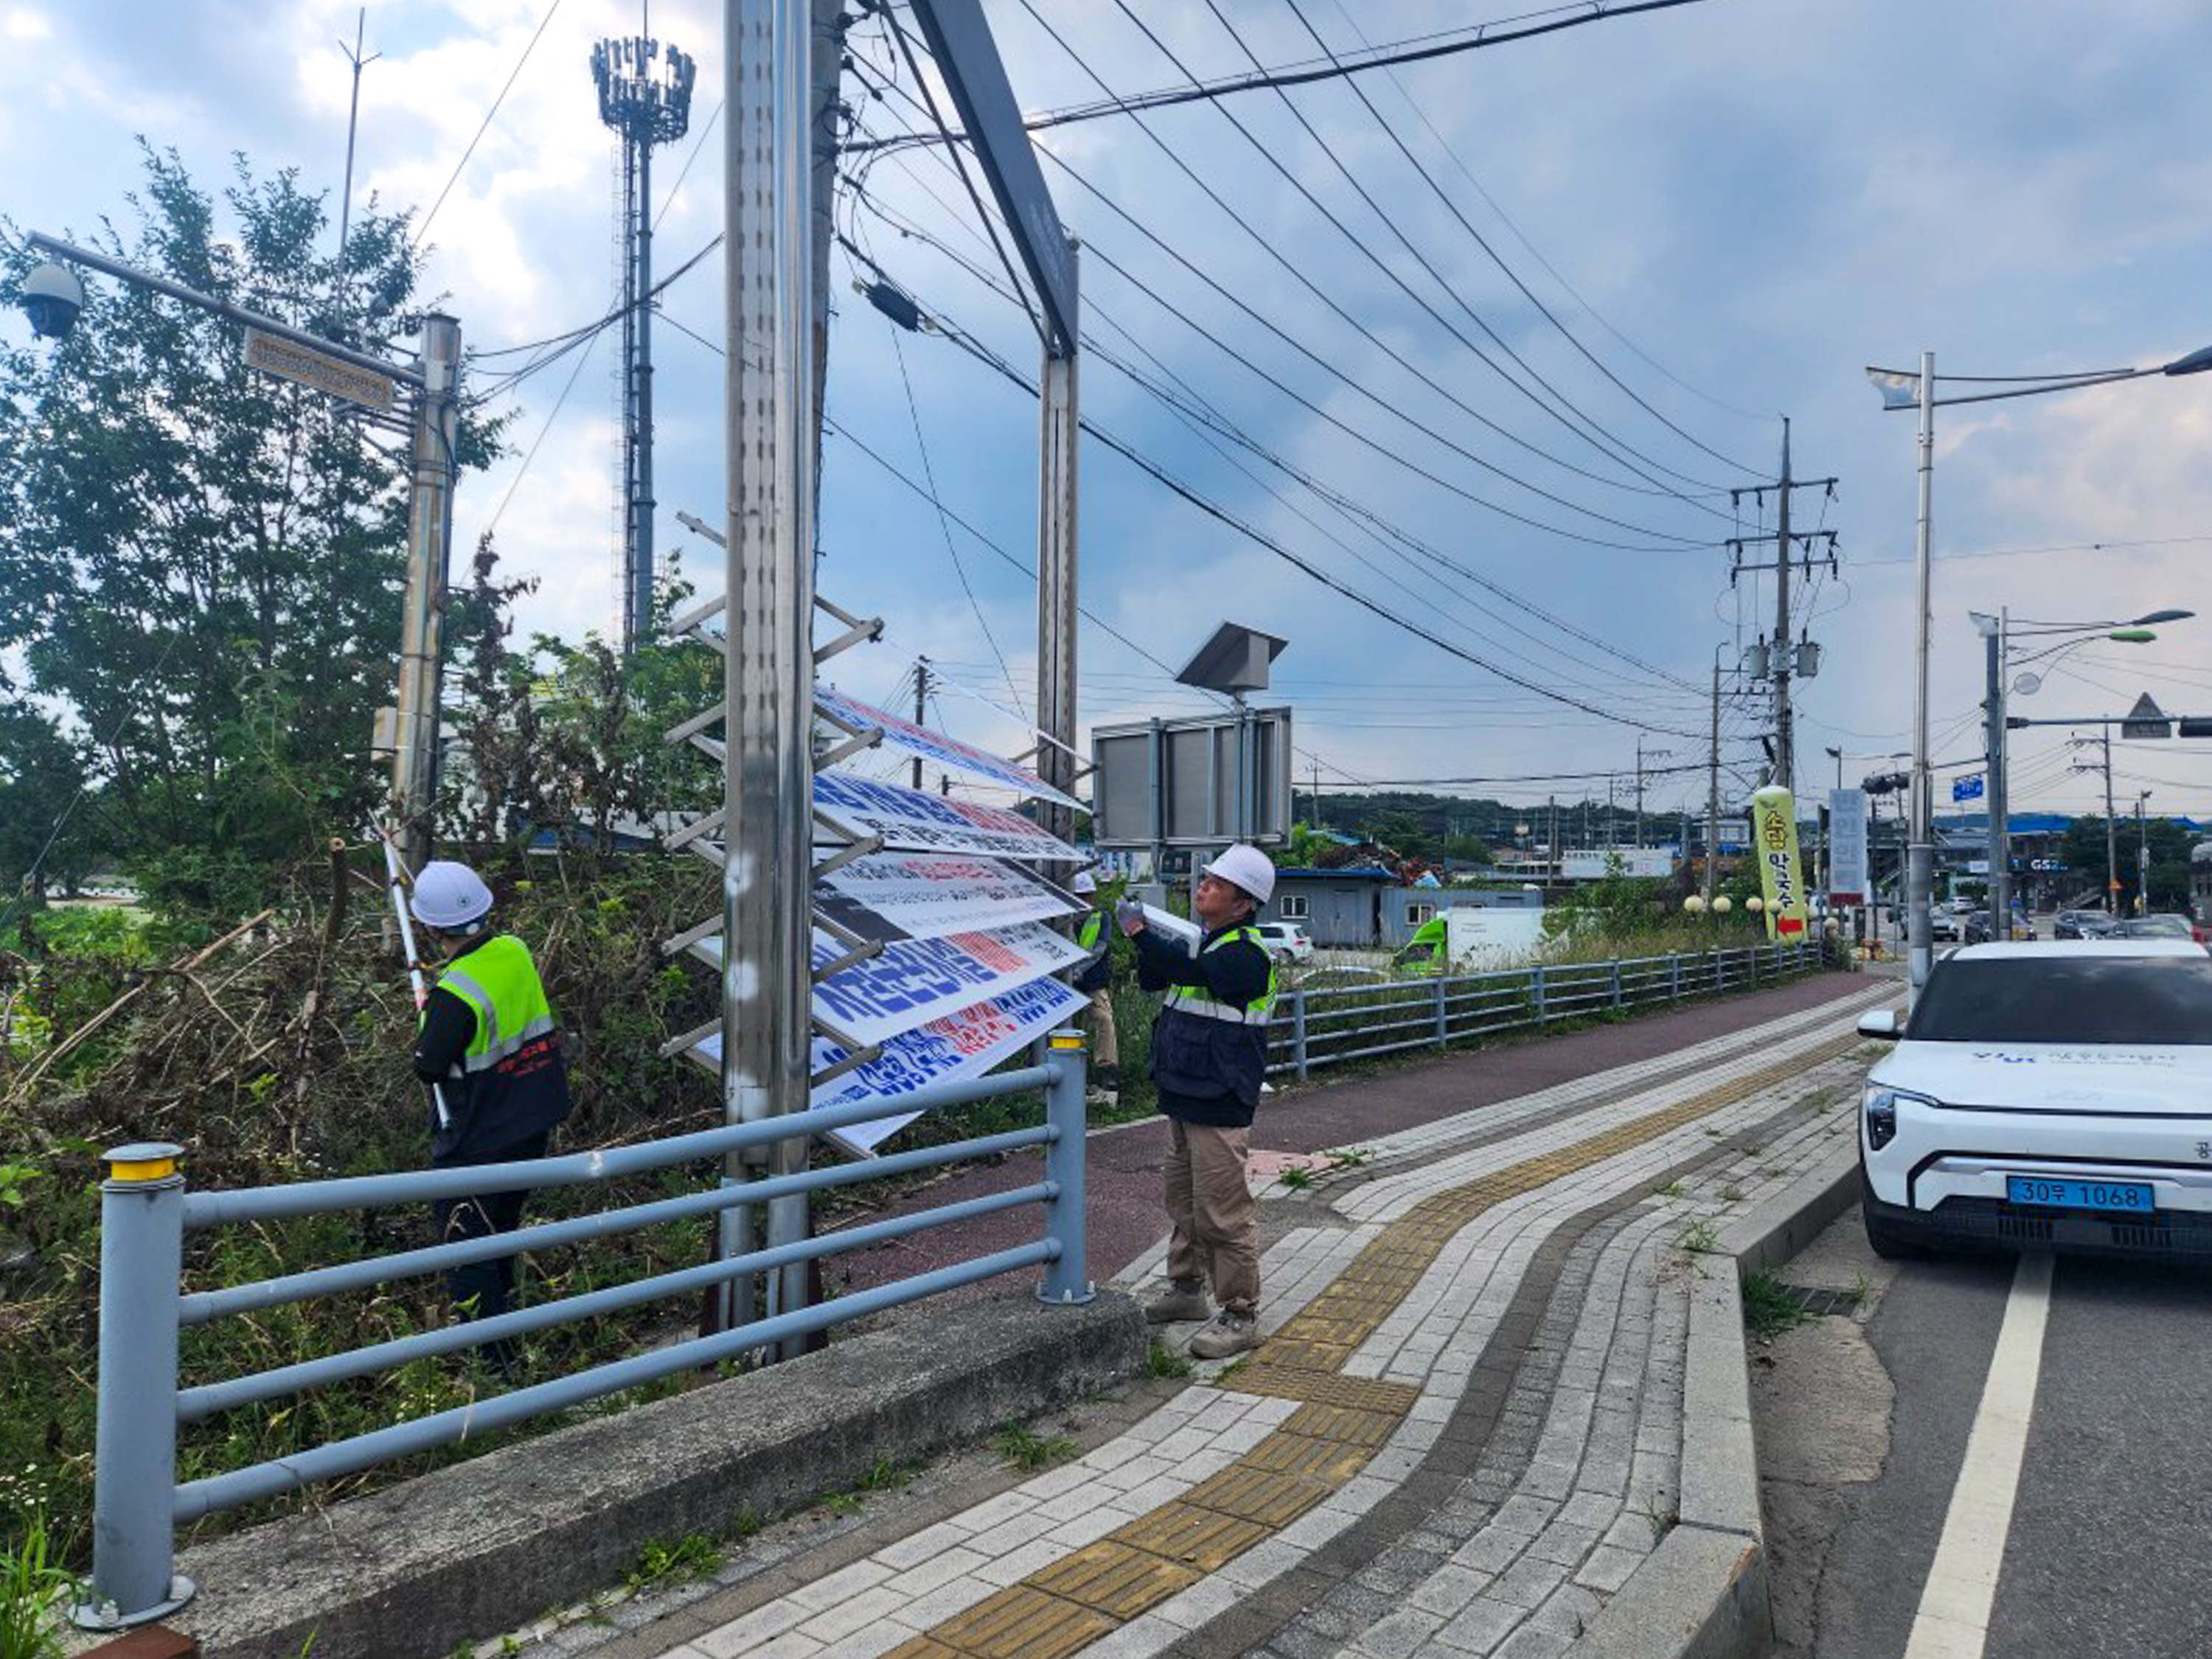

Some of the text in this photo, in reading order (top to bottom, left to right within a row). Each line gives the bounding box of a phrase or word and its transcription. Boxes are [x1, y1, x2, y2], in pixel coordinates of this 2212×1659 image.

[1769, 852, 1795, 909] 막국수
[2022, 1182, 2140, 1207] 30무 1068
